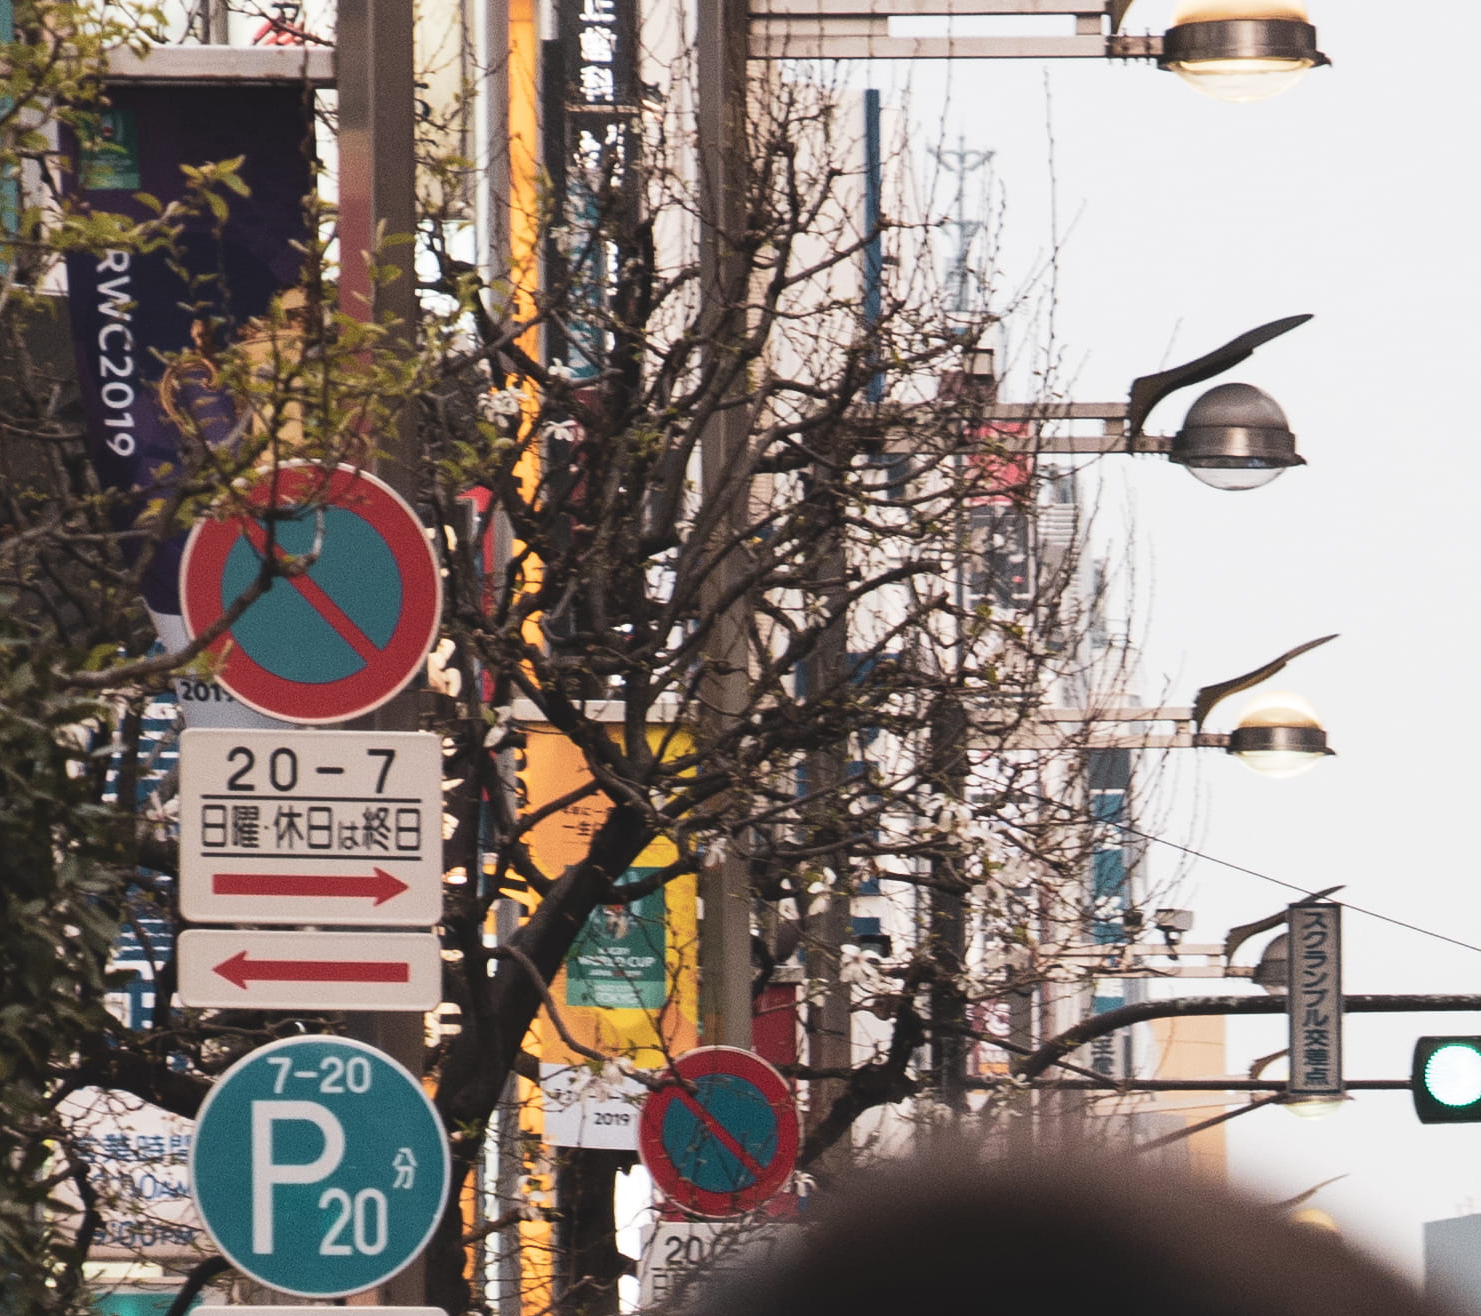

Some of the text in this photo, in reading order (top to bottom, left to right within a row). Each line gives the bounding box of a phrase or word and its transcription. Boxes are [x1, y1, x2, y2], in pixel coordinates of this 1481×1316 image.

[94, 246, 136, 458] RWC2019
[201, 803, 421, 851] 日曜・休日は終日
[1302, 911, 1330, 1086] スクランブル交差点
[266, 1056, 372, 1095] 7-20
[593, 1112, 632, 1126] 2019
[251, 1099, 347, 1255] P
[392, 1146, 417, 1190] 分
[318, 1187, 389, 1257] 20
